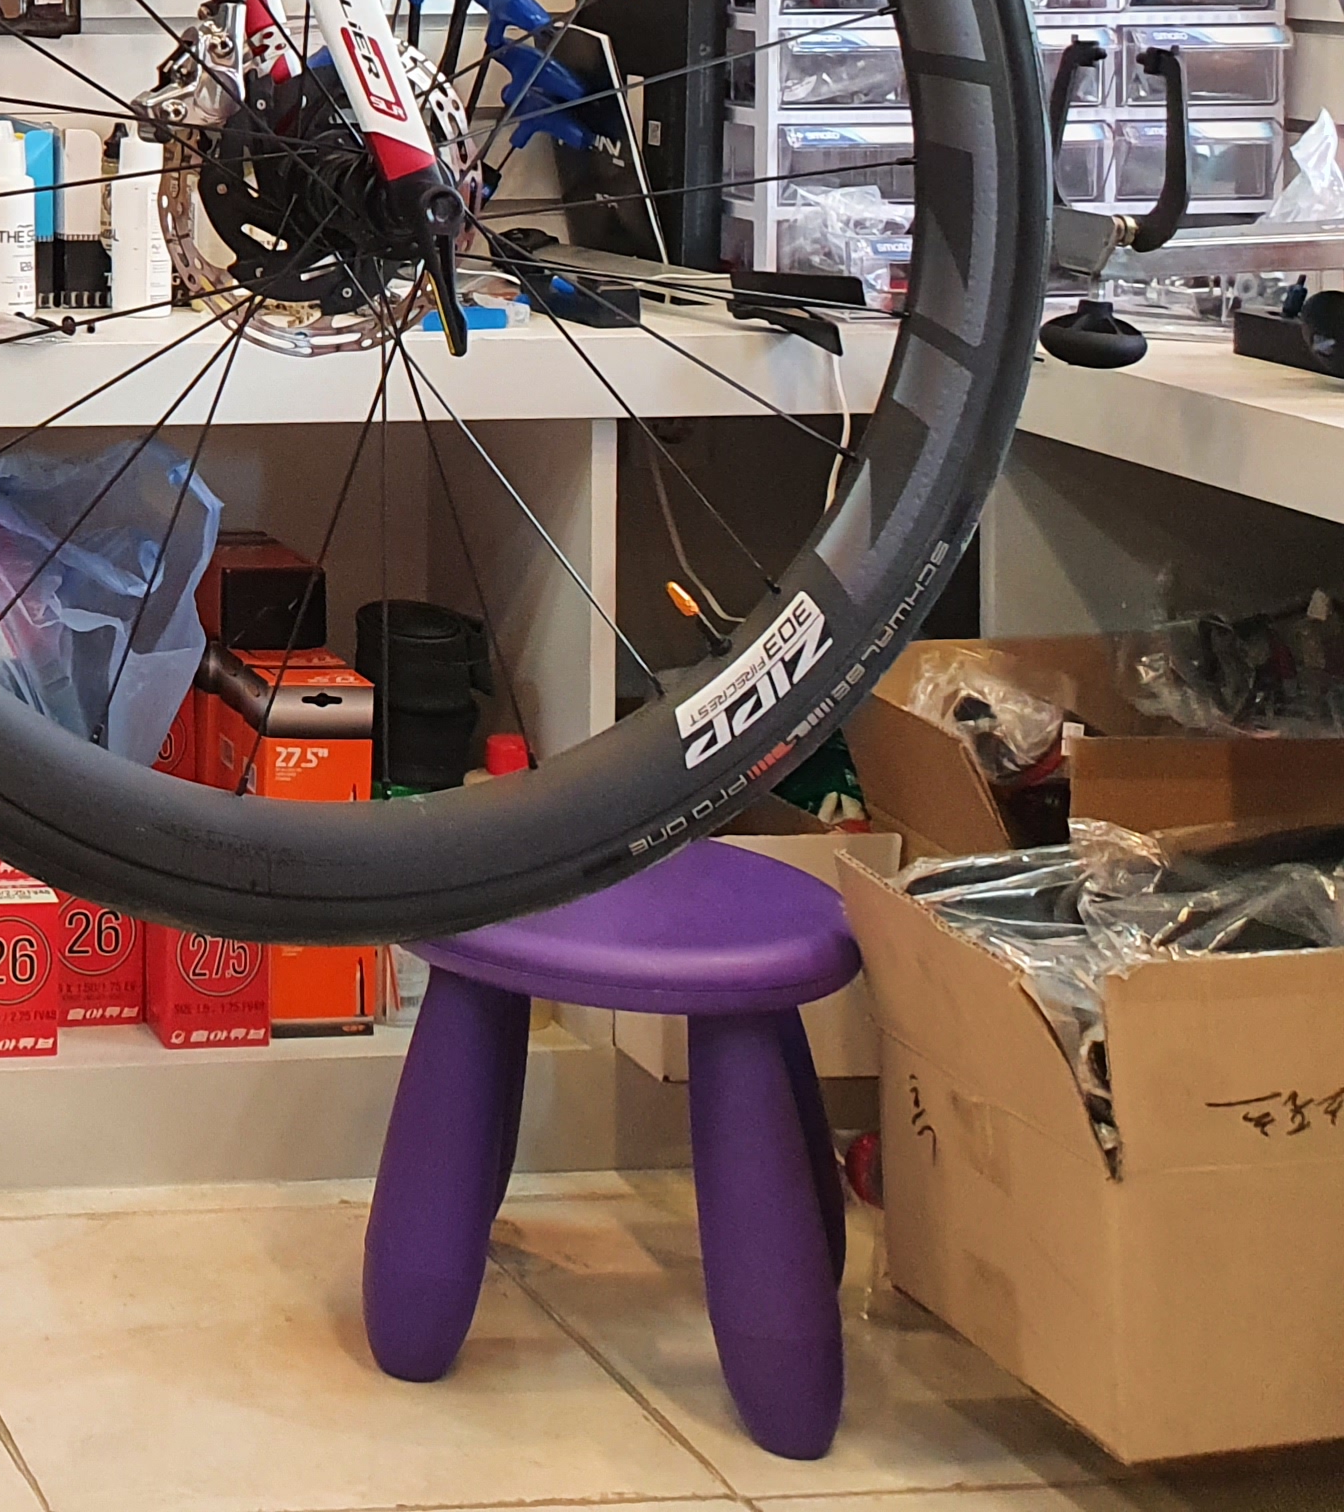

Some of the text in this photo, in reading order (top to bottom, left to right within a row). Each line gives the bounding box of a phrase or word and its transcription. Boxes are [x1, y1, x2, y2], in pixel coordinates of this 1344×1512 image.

[689, 598, 814, 727] 303 FIRECREST
[833, 540, 950, 702] SCHWALBE
[684, 613, 834, 771] ZIPP
[65, 909, 121, 956] 26
[188, 935, 249, 981] 27.5
